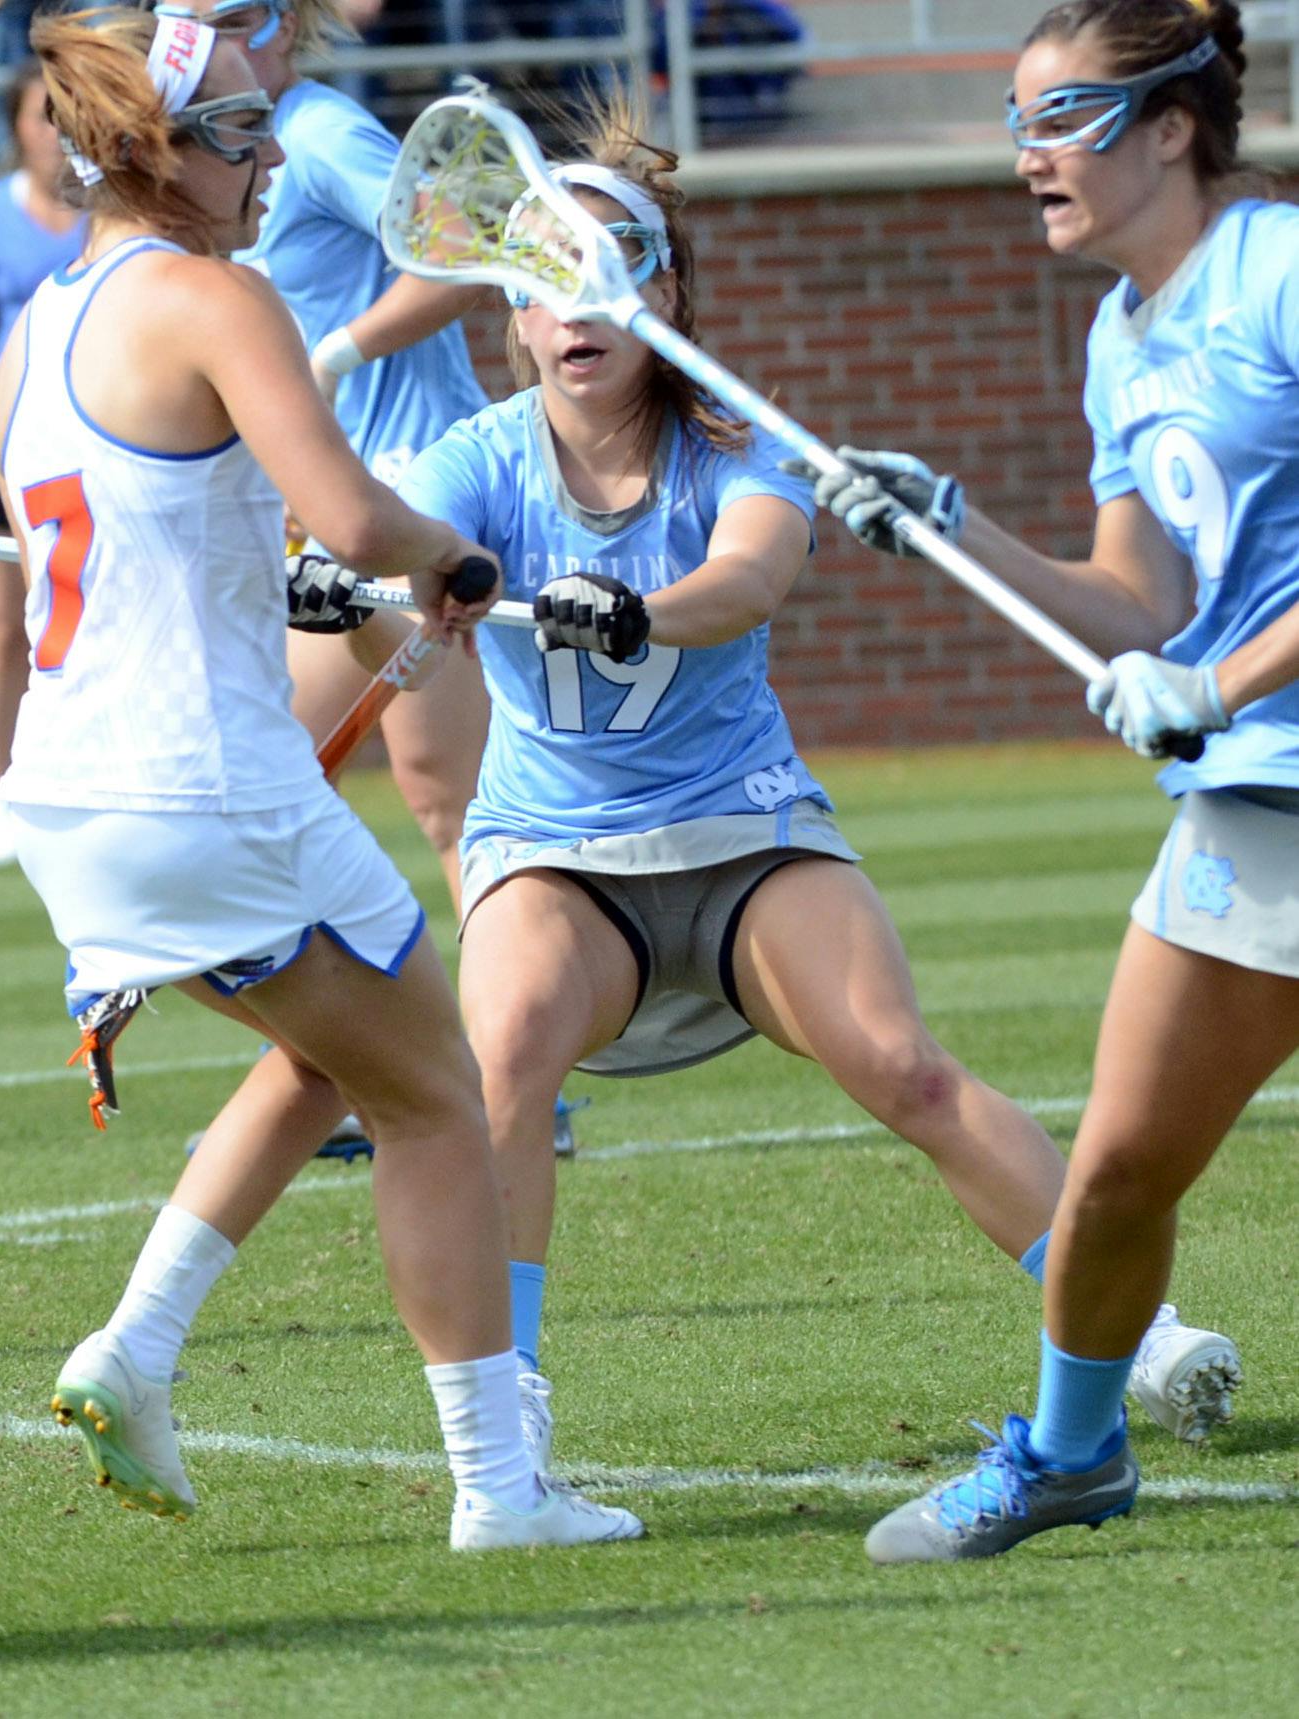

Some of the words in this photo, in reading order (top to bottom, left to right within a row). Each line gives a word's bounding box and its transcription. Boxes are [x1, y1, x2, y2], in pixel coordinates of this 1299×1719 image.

[21, 468, 95, 673] 7
[1151, 424, 1230, 582] 9
[542, 642, 682, 734] 19
